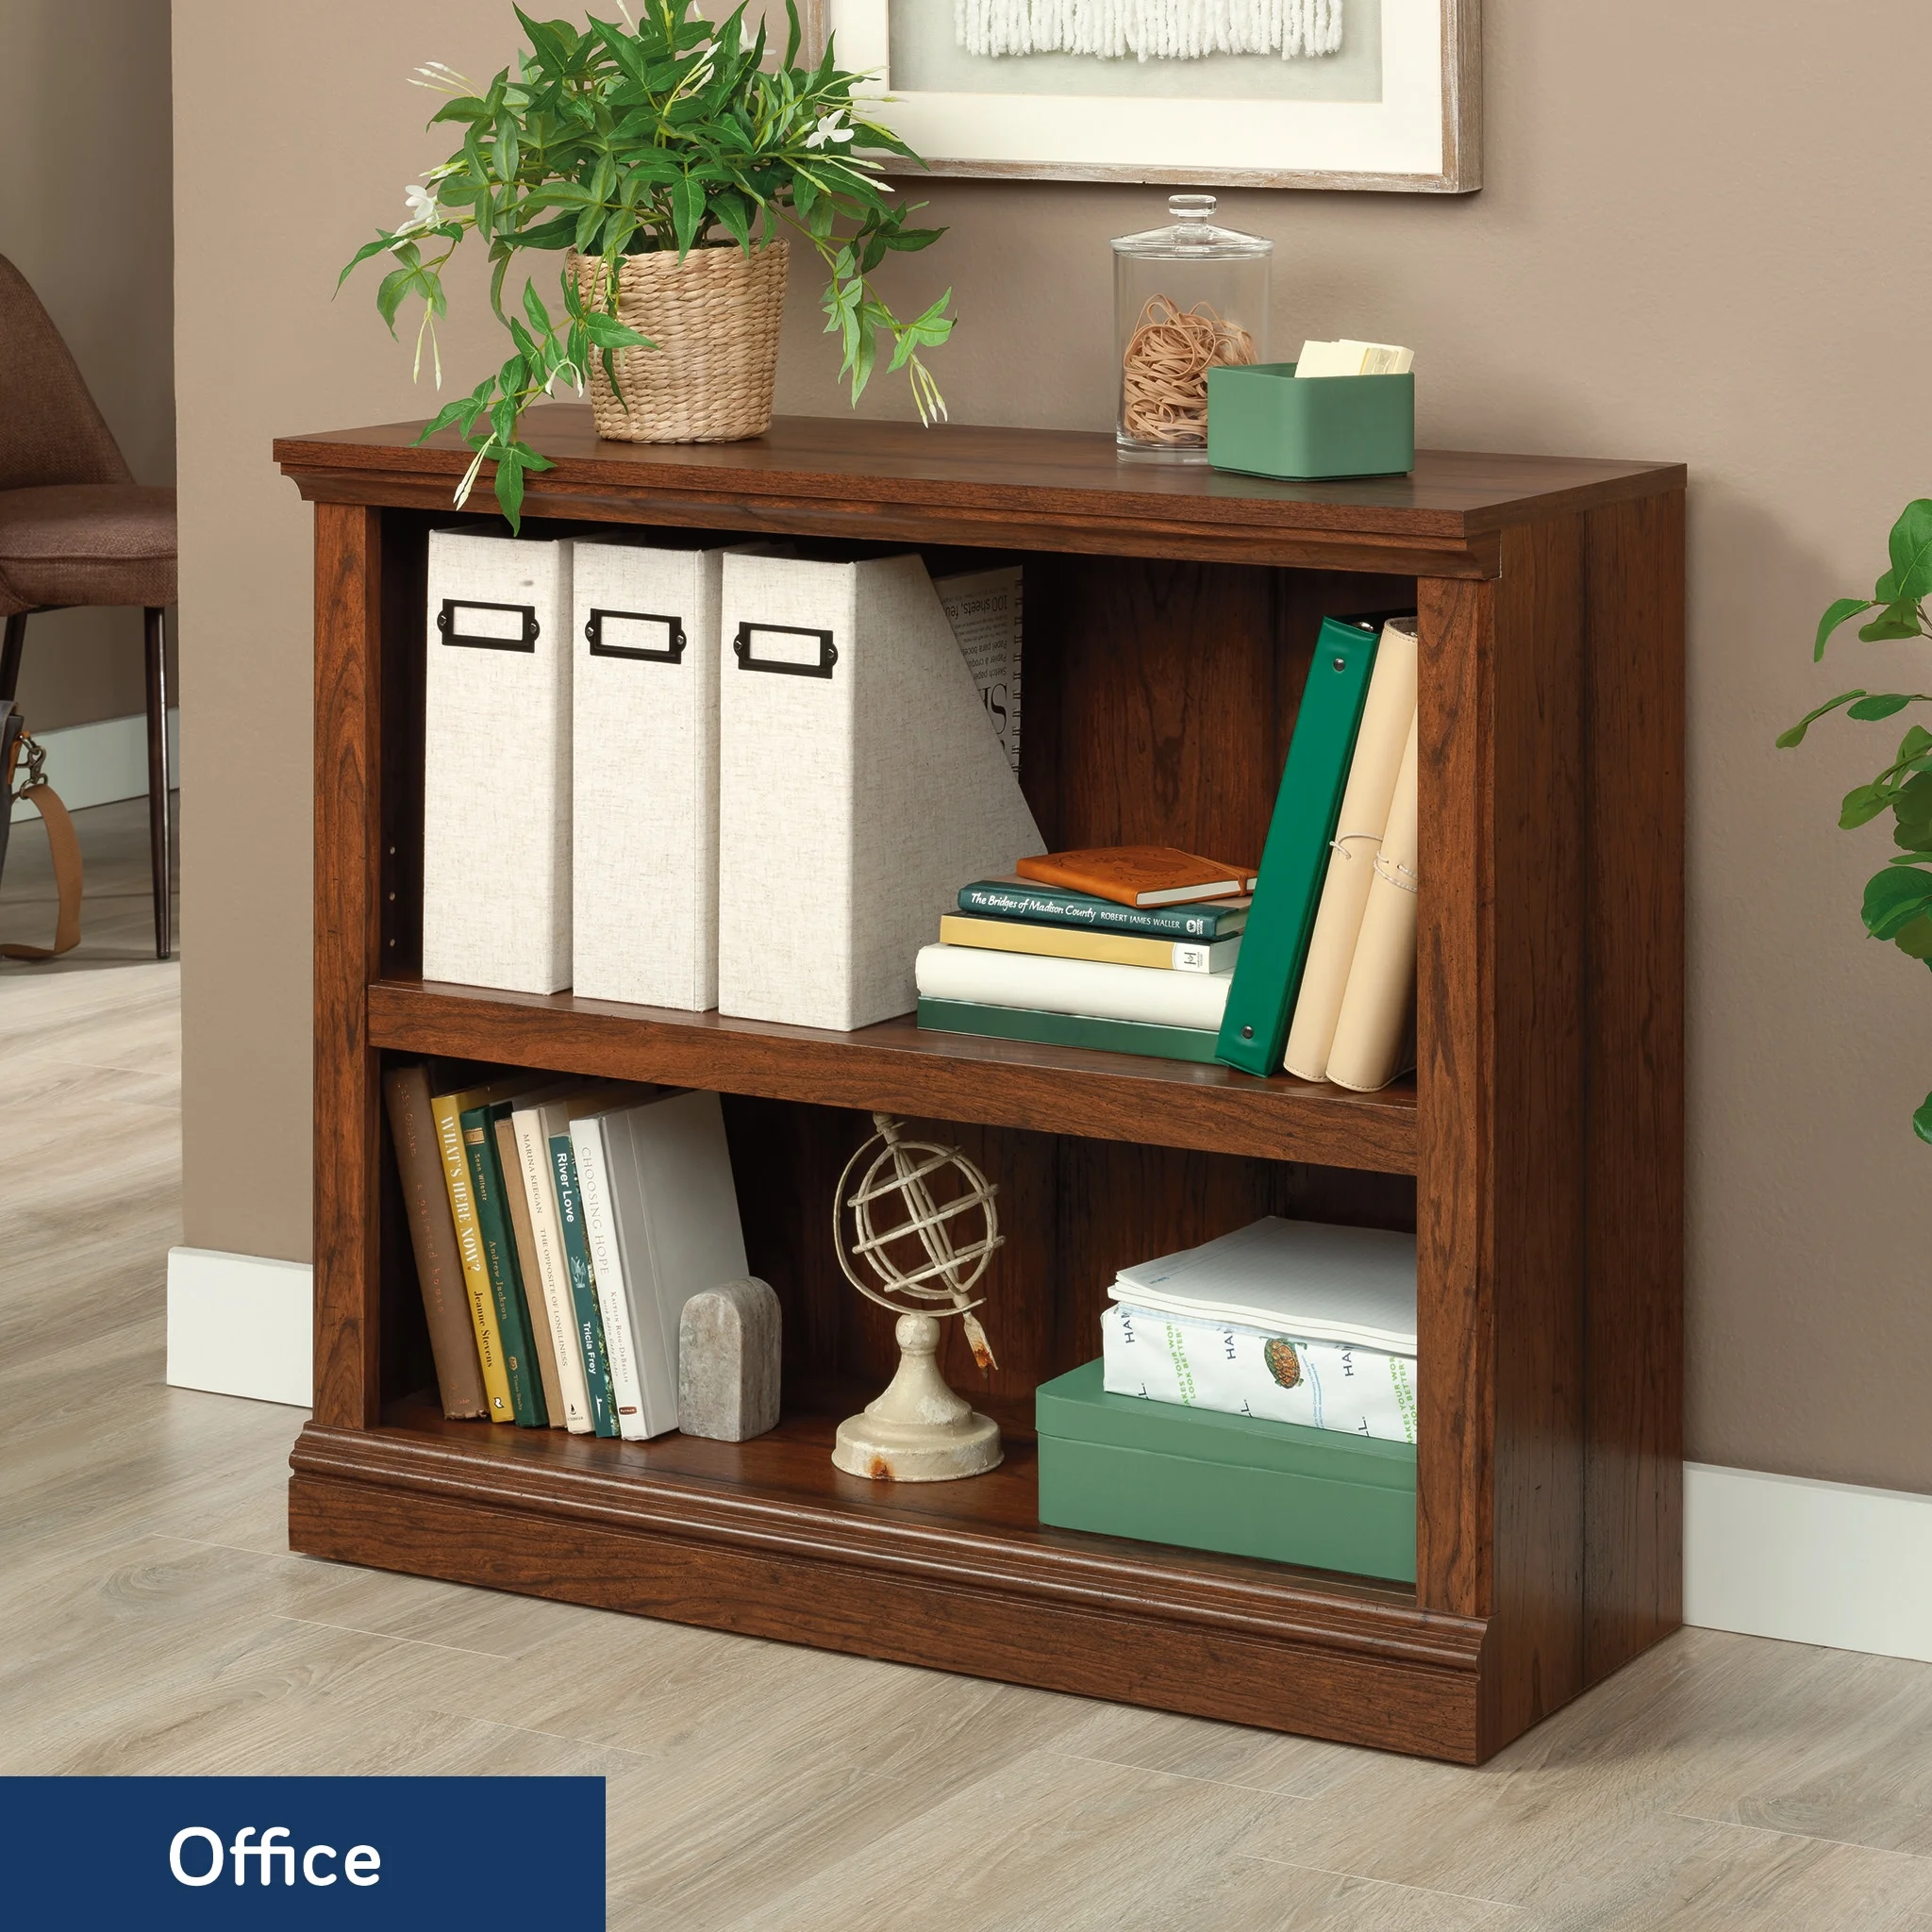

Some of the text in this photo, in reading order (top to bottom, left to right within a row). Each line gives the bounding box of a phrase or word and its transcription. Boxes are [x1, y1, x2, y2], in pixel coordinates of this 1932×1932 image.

[961, 598, 991, 616] sheets,
[991, 594, 1008, 612] 100
[989, 666, 1008, 678] Sketch
[971, 892, 1180, 928] The Bridges of Madison County ROBERT JAMES WALLER
[441, 1116, 481, 1272] WHAT'S HERE NOW?
[523, 1133, 542, 1214] MARINA KEEGAN
[557, 1153, 575, 1223] River Love
[581, 1146, 609, 1274] CHOOSING HOPE
[489, 1241, 507, 1320] Andrew Jackson
[543, 1249, 556, 1294] OPPOSITE
[551, 1294, 558, 1307] OF
[474, 1291, 492, 1368] Jeanne Stevens
[554, 1309, 568, 1367] LONELINESS
[583, 1321, 596, 1374] Tricia Frey
[1172, 1351, 1183, 1378] YOUR
[1186, 1372, 1196, 1399] LOOK
[1394, 1384, 1406, 1410] YOUR
